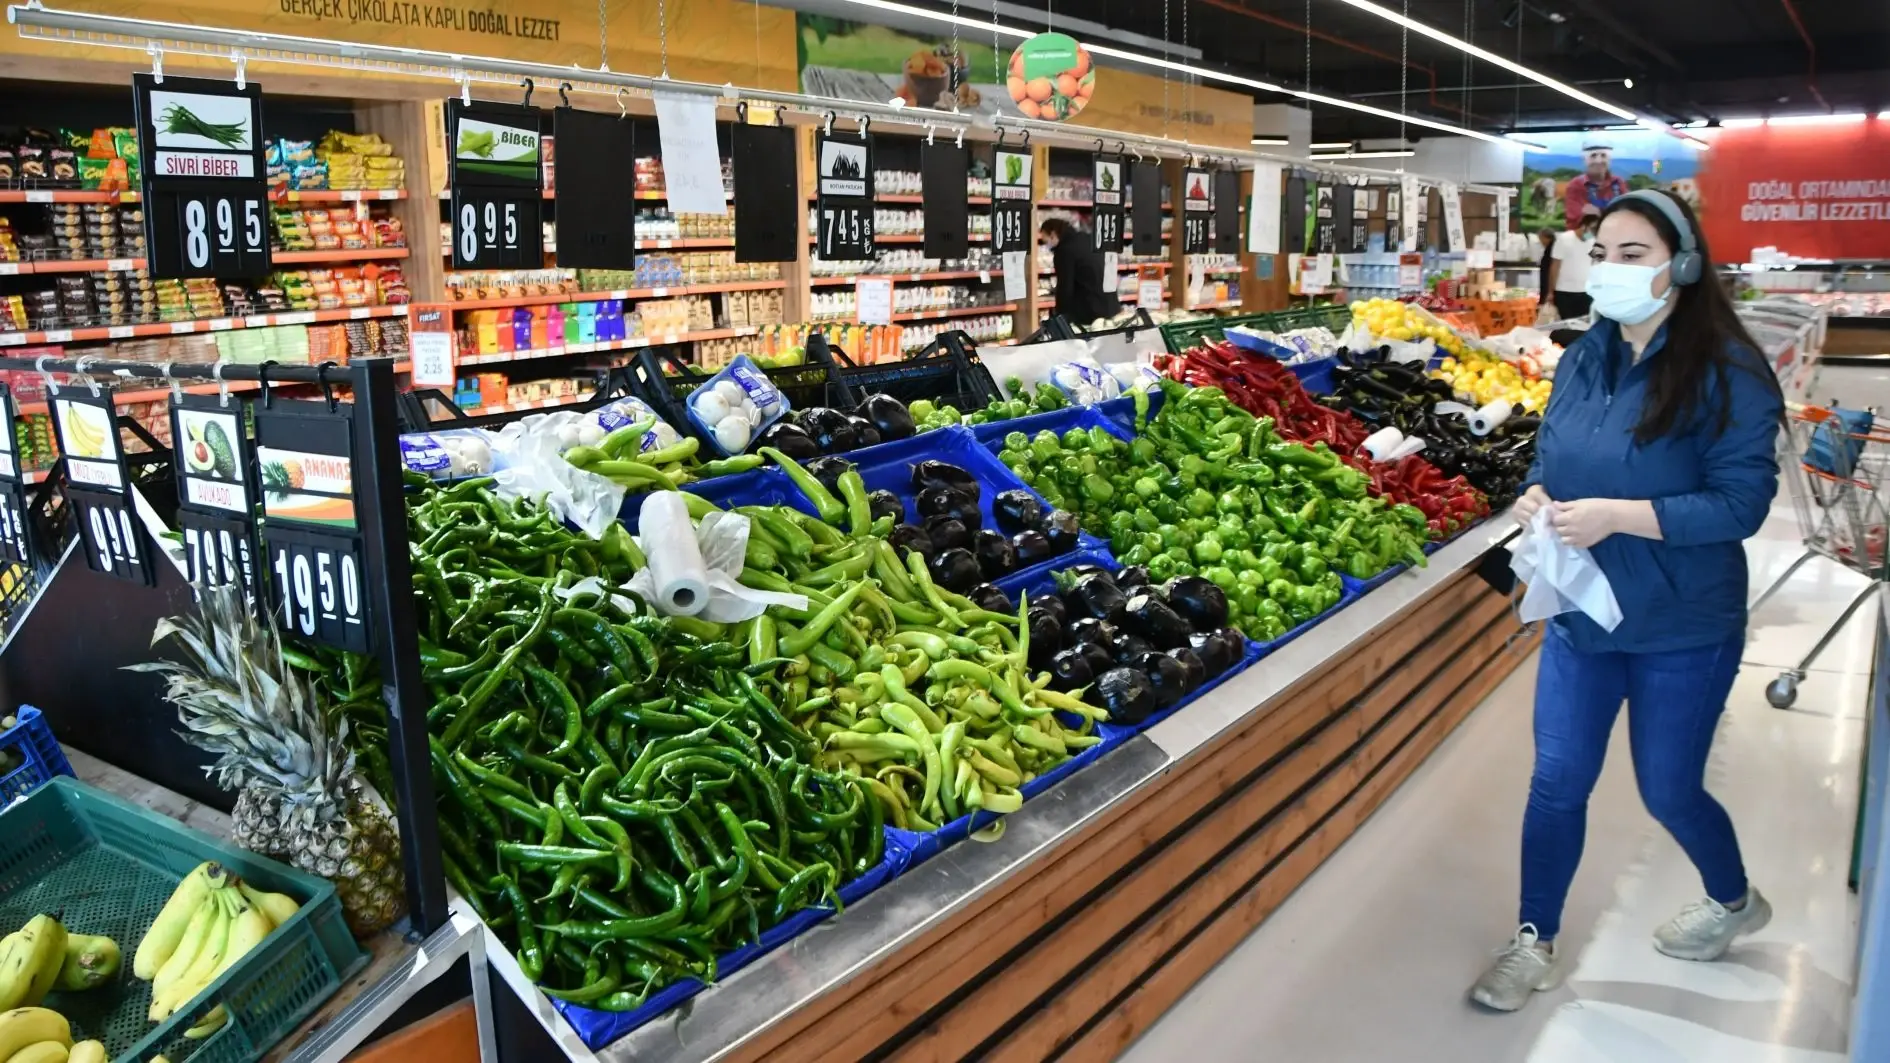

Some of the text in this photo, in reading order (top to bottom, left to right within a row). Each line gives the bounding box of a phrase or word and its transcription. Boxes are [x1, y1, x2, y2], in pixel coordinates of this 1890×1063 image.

[280, 0, 561, 41] GERÇEK ÇIKOLATA KAPLI DOĞAL LEZZET
[501, 128, 536, 149] BİBER
[166, 154, 239, 177] SİVRİ BİBER
[1748, 180, 1795, 200] DOĞAL
[304, 458, 351, 481] ANANAS
